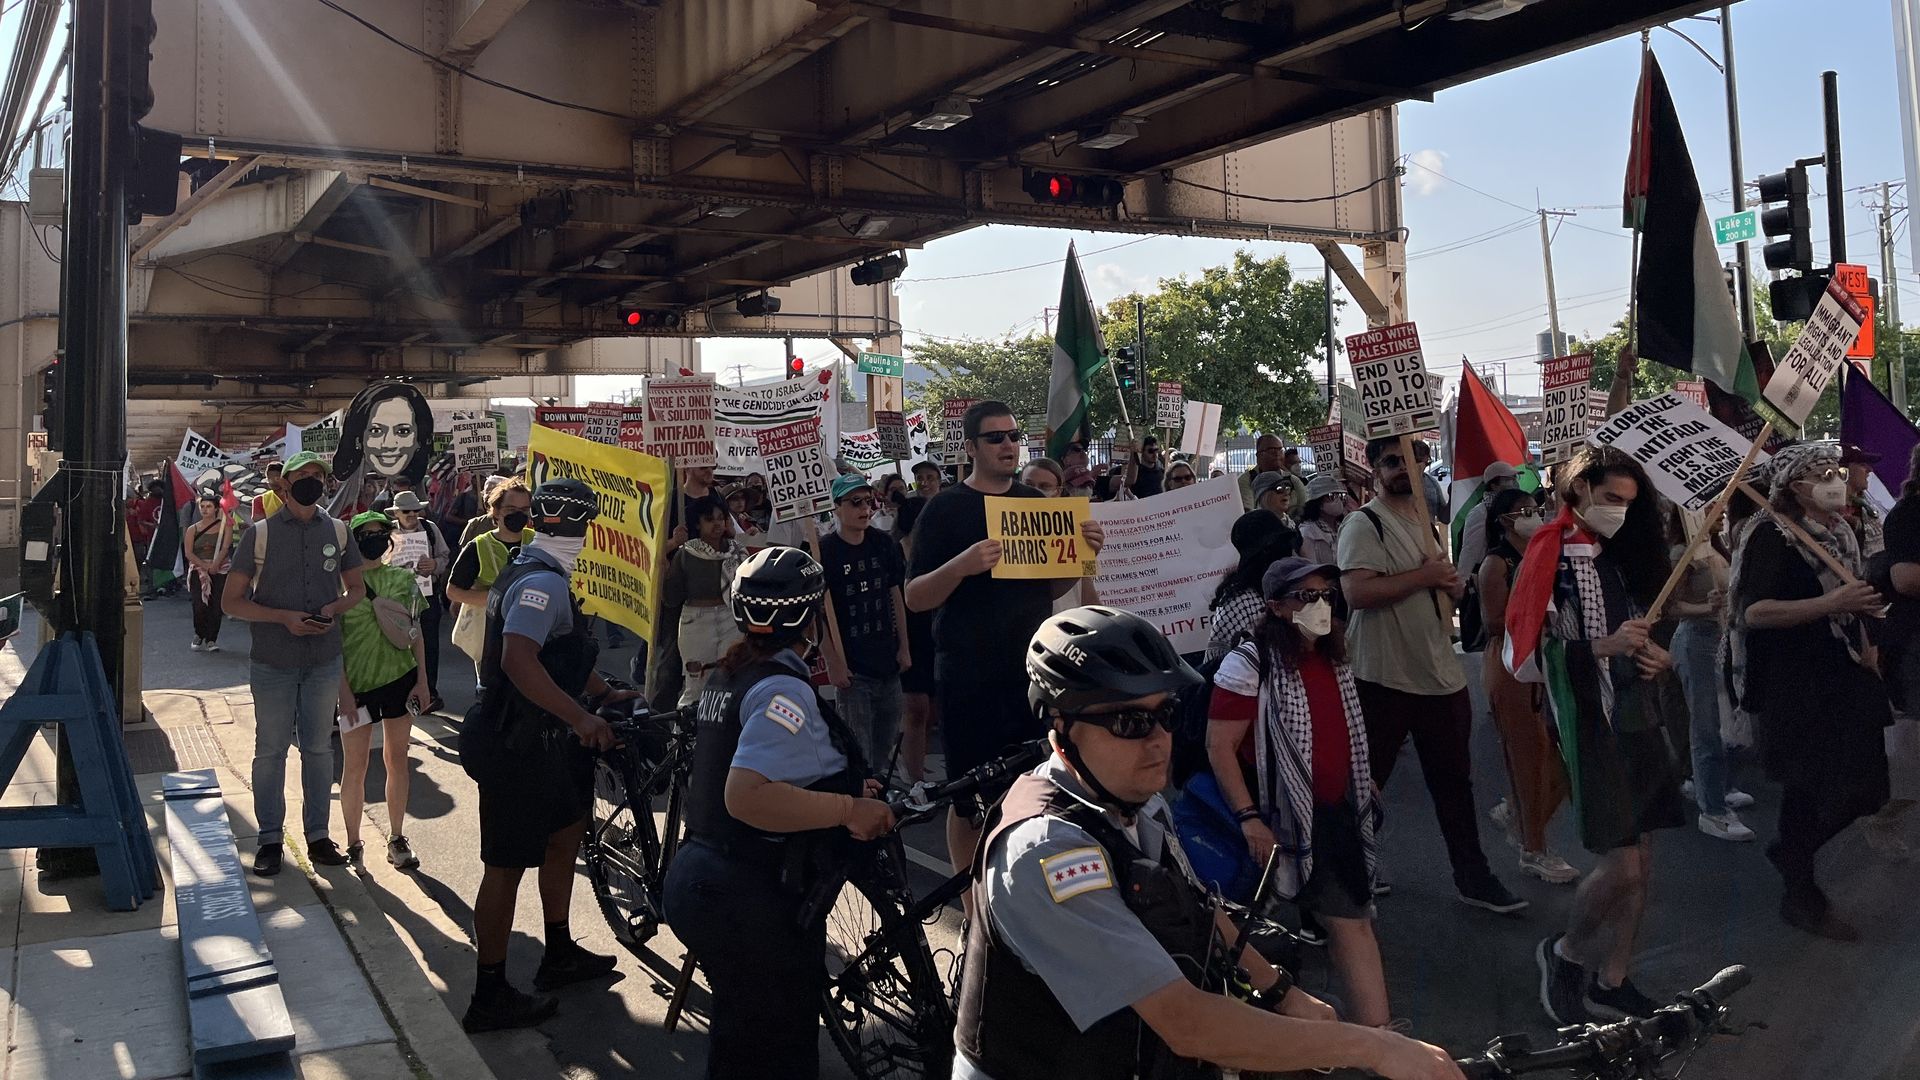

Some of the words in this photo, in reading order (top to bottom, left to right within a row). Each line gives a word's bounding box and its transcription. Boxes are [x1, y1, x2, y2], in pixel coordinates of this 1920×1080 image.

[1720, 219, 1740, 230] Lake
[1726, 233, 1738, 241] 200
[1840, 272, 1866, 289] WEST
[1816, 304, 1852, 346] IMMIGRANT
[1347, 331, 1383, 348] STAND
[1387, 325, 1415, 339] WITH
[1806, 322, 1829, 347] RIGHTS
[1830, 343, 1842, 360] AND
[1351, 338, 1418, 362] PALESTINE!
[1800, 337, 1834, 372] LEGALIZATION
[864, 356, 890, 365] Paulina
[1357, 363, 1388, 382] END
[1394, 356, 1420, 374] U.S
[1545, 359, 1568, 373] STAND
[1572, 355, 1591, 367] WITH
[1786, 348, 1805, 372] FOR
[1804, 368, 1826, 391] ALL!
[1545, 368, 1589, 386] PALESTINE!
[761, 390, 772, 399] TO
[776, 383, 804, 398] ISRAEL
[1362, 380, 1392, 400] AID
[1399, 373, 1424, 392] TO
[650, 396, 673, 408] THERE
[677, 396, 685, 407] IS
[689, 395, 711, 407] ONLY
[723, 399, 740, 408] THE
[1364, 392, 1430, 418] ISRAEL!
[1546, 391, 1566, 408] END
[1570, 386, 1586, 402] U.S
[668, 409, 711, 421] SOLUTION
[1545, 408, 1565, 426] AID
[1570, 403, 1586, 420] TO
[1596, 394, 1682, 444] GLOBALIZE
[454, 422, 493, 431] RESISTANCE
[586, 427, 601, 435] AID
[654, 425, 705, 441] INTIFADA
[759, 428, 788, 442] STAND
[791, 422, 814, 434] WITH
[947, 420, 962, 429] END
[1544, 421, 1585, 444] ISRAEL!
[1635, 415, 1673, 436] THE
[304, 434, 338, 442] CHICAGO
[459, 435, 491, 444] JUSTIFIED
[762, 433, 817, 454] PALESTINE!
[946, 431, 962, 441] AID
[1632, 420, 1711, 464] INTIFADA
[647, 441, 713, 458] REVOLUTION
[728, 447, 758, 456] RIVER
[946, 443, 965, 452] ISRA
[1315, 444, 1331, 452] END
[1658, 443, 1700, 473] FIGHT
[1695, 436, 1727, 451] THE
[180, 462, 195, 470] AID
[182, 456, 200, 466] END
[462, 458, 493, 466] OCCUPIED!
[766, 455, 792, 471] END
[797, 448, 819, 463] U.S
[1318, 453, 1333, 462] AID
[1672, 460, 1706, 481] U.S.
[1700, 446, 1739, 464] WAR
[771, 470, 796, 488] AID
[802, 463, 823, 479] TO
[1318, 463, 1339, 472] ISRA
[550, 456, 572, 478] STOP
[591, 468, 637, 500] FUNDING
[774, 479, 827, 502] ISRAEL!
[1137, 511, 1170, 523] ELECTION
[1172, 503, 1193, 515] AFTER
[1001, 511, 1075, 536] ABANDON
[1106, 524, 1154, 535] LEGALIZATION
[1157, 519, 1176, 528] NOW!
[590, 520, 606, 552] TO
[1123, 540, 1148, 549] RIGHTS
[1166, 533, 1180, 541] ALL!
[1003, 539, 1048, 564] HARRIS
[1132, 553, 1157, 562] CONGO
[590, 561, 616, 582] POWER
[1110, 572, 1137, 580] CRIMES
[1139, 568, 1159, 577] NOW!
[588, 579, 597, 597] LA
[599, 582, 620, 604] LUCHA
[622, 591, 633, 610] FOR
[1157, 590, 1175, 599] WAR!
[1165, 602, 1191, 613] STRIKE!
[1162, 619, 1194, 636] LITY
[1059, 640, 1088, 666] LICE
[201, 890, 248, 920] CROSS
